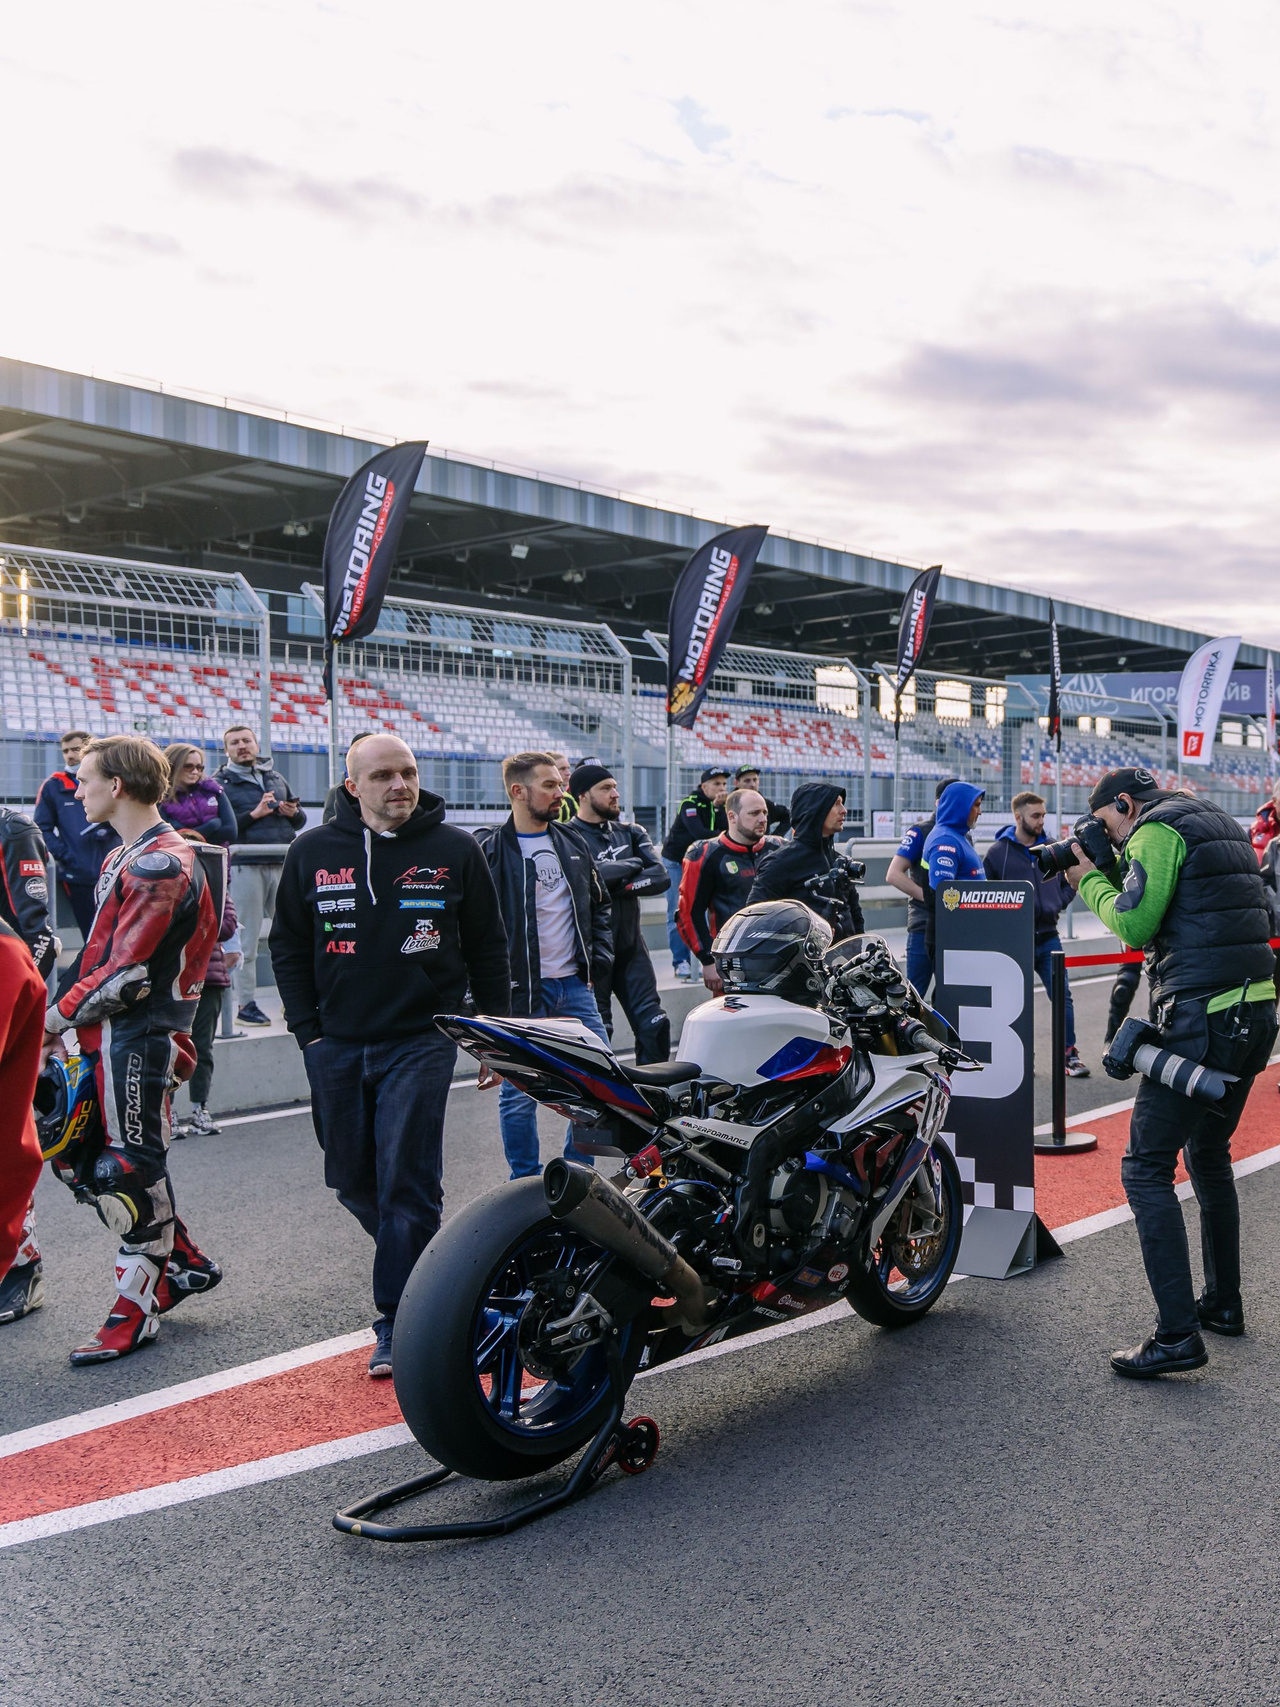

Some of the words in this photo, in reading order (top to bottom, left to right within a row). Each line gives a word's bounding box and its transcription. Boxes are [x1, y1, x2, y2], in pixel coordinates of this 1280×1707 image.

[679, 546, 732, 681] MOTORING
[697, 622, 717, 679] ЧЕМПИОНАТ
[728, 562, 738, 581] 2021
[1194, 650, 1221, 728] MOTORRIKA
[317, 898, 356, 911] BS
[961, 891, 1026, 904] MOTORING
[944, 949, 1025, 1100] 3
[71, 1100, 93, 1139] HJC
[125, 1052, 143, 1146] NFMOTO
[693, 1124, 750, 1147] PERFORMANCE
[753, 1306, 788, 1320] METZELER
